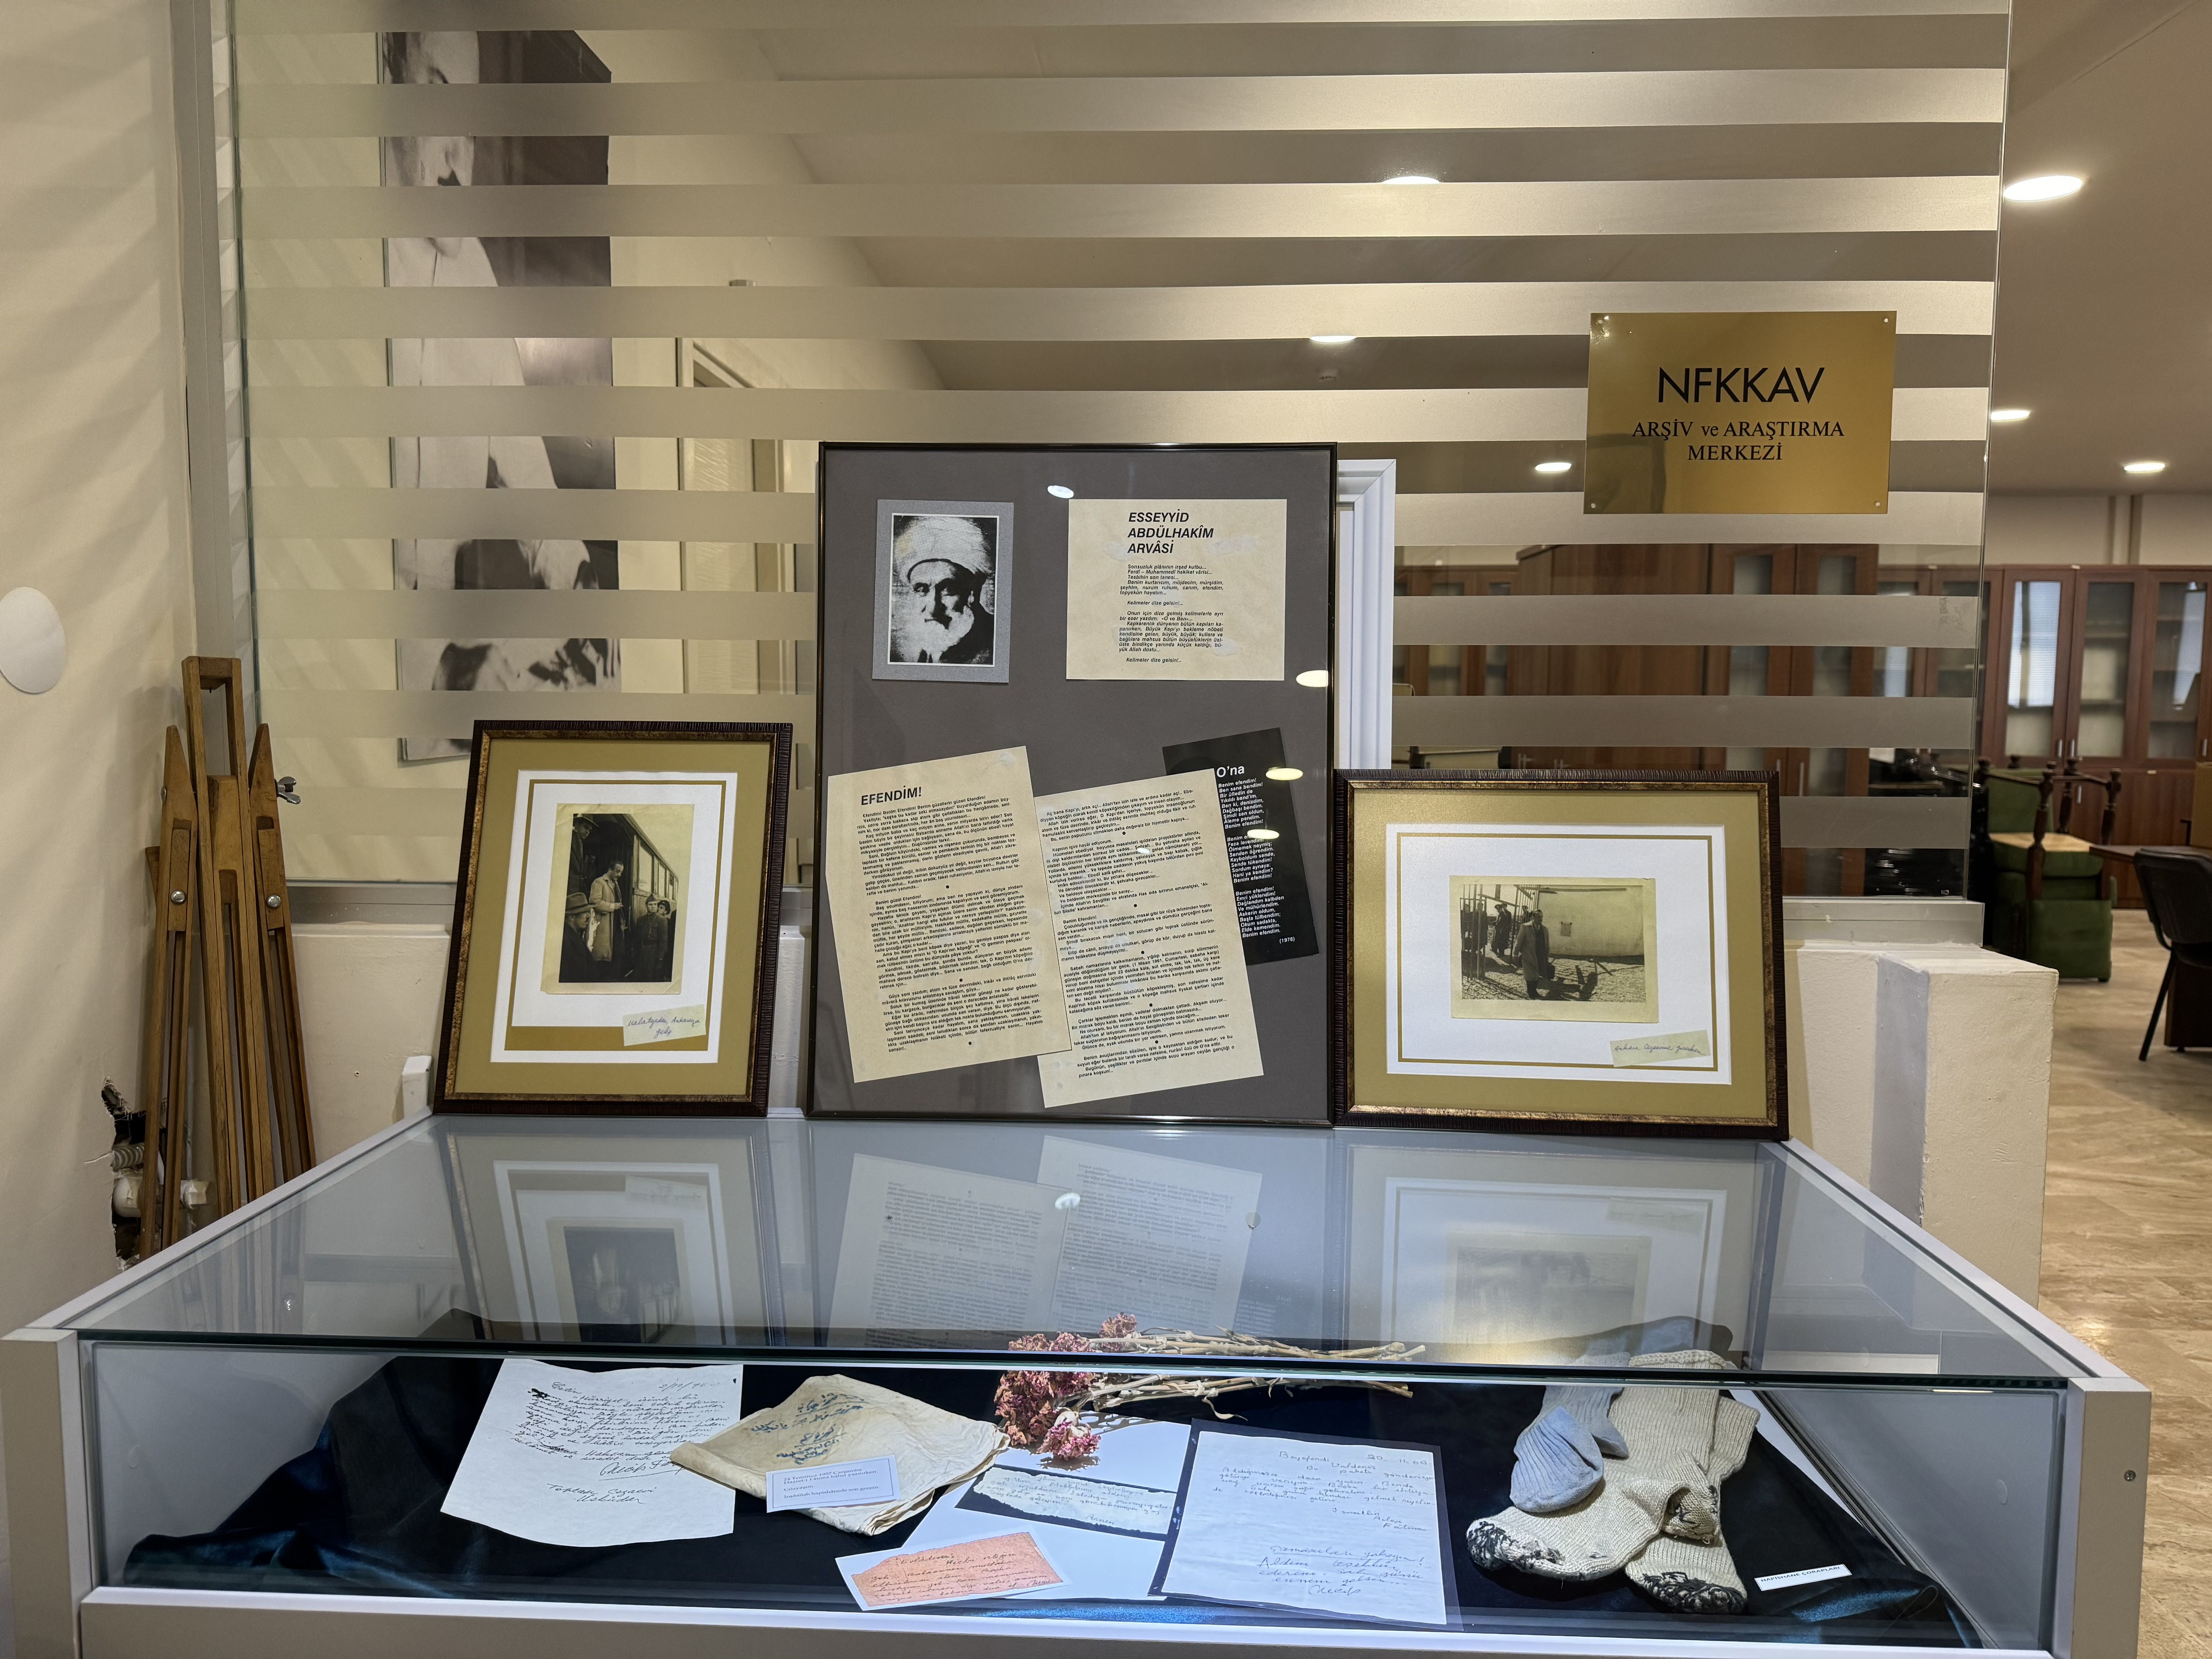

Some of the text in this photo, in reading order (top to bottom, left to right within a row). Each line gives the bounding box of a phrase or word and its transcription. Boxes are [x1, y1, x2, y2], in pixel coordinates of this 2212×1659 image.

[1658, 367, 1825, 403] NFKKAV
[1632, 419, 1844, 441] ARŞİV ve ARAŞTIRMA
[1688, 442, 1783, 460] MERKEZİ
[1128, 509, 1189, 522] ESSEYYİD
[1127, 525, 1214, 538] ABDÜLHAKÎM
[1127, 540, 1174, 554] ARVÂSİ
[1217, 766, 1244, 777] O'na
[861, 785, 921, 805] EFENDİM!
[1248, 857, 1272, 865] tükendim!
[1249, 891, 1275, 901] yüklendim!
[1246, 902, 1279, 910] mühürlendim.
